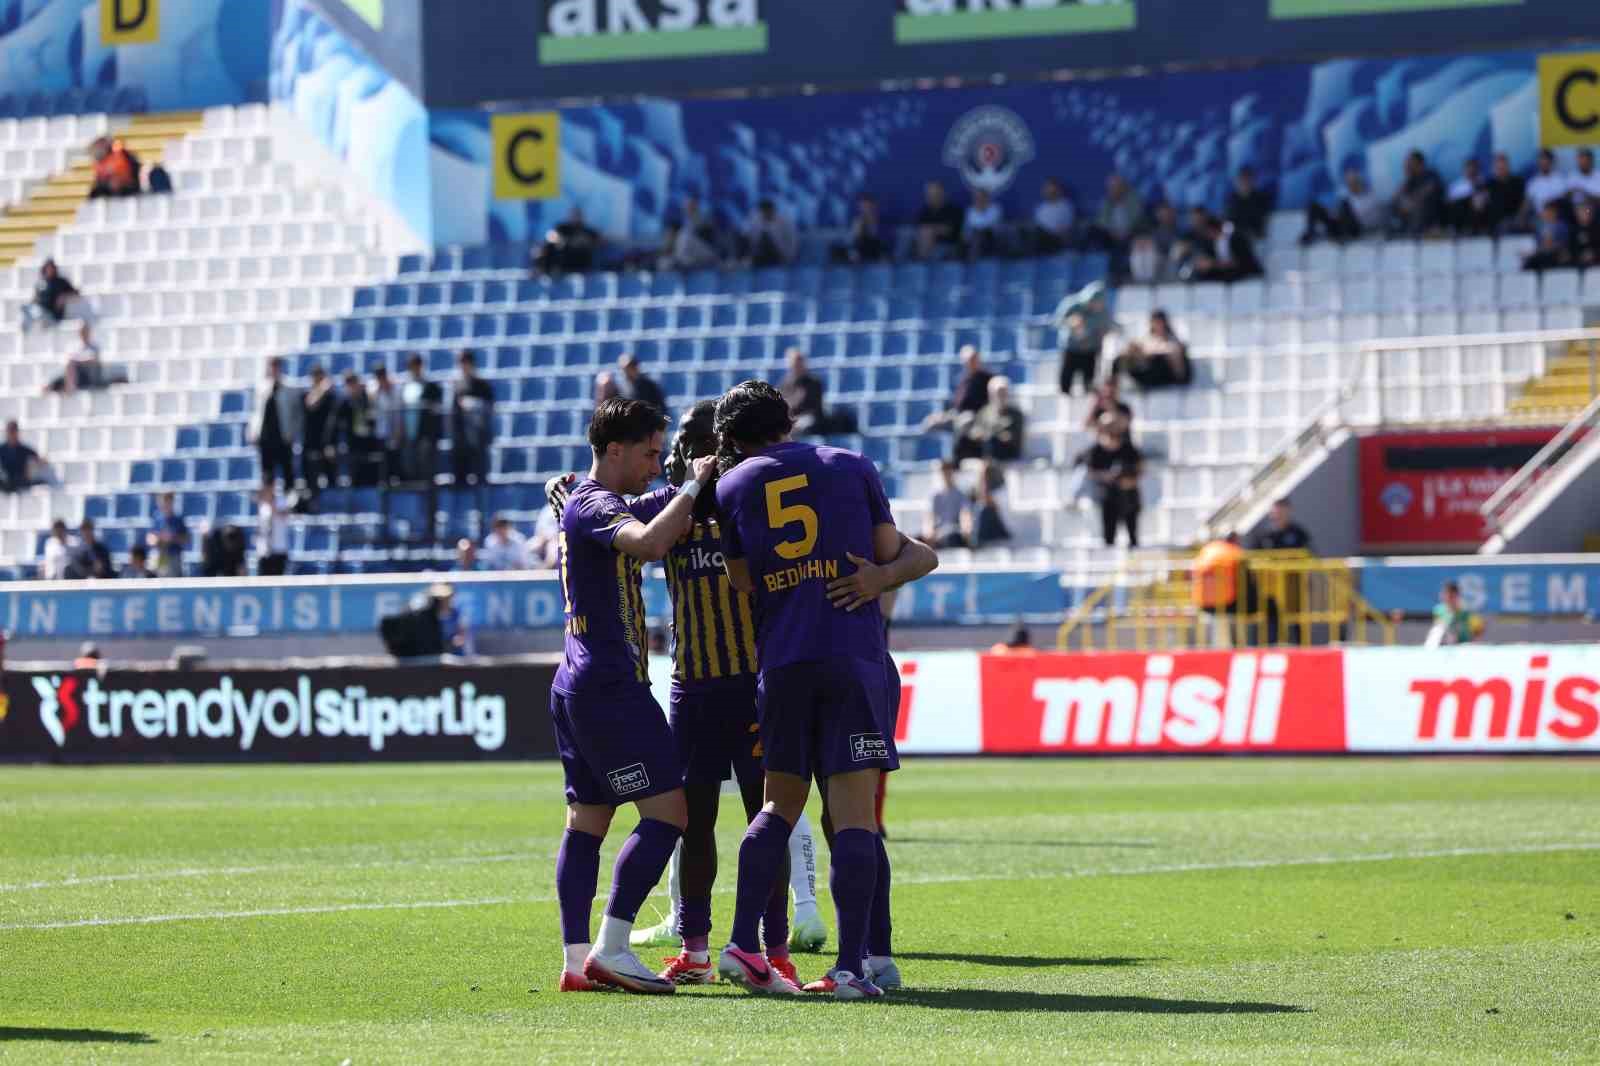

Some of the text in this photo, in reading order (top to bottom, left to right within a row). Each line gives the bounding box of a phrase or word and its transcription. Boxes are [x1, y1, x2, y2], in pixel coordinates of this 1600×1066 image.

[1554, 69, 1600, 133] C
[507, 129, 545, 184] C
[765, 473, 819, 560] 5
[83, 676, 311, 750] trendyol
[1032, 653, 1289, 746] misli
